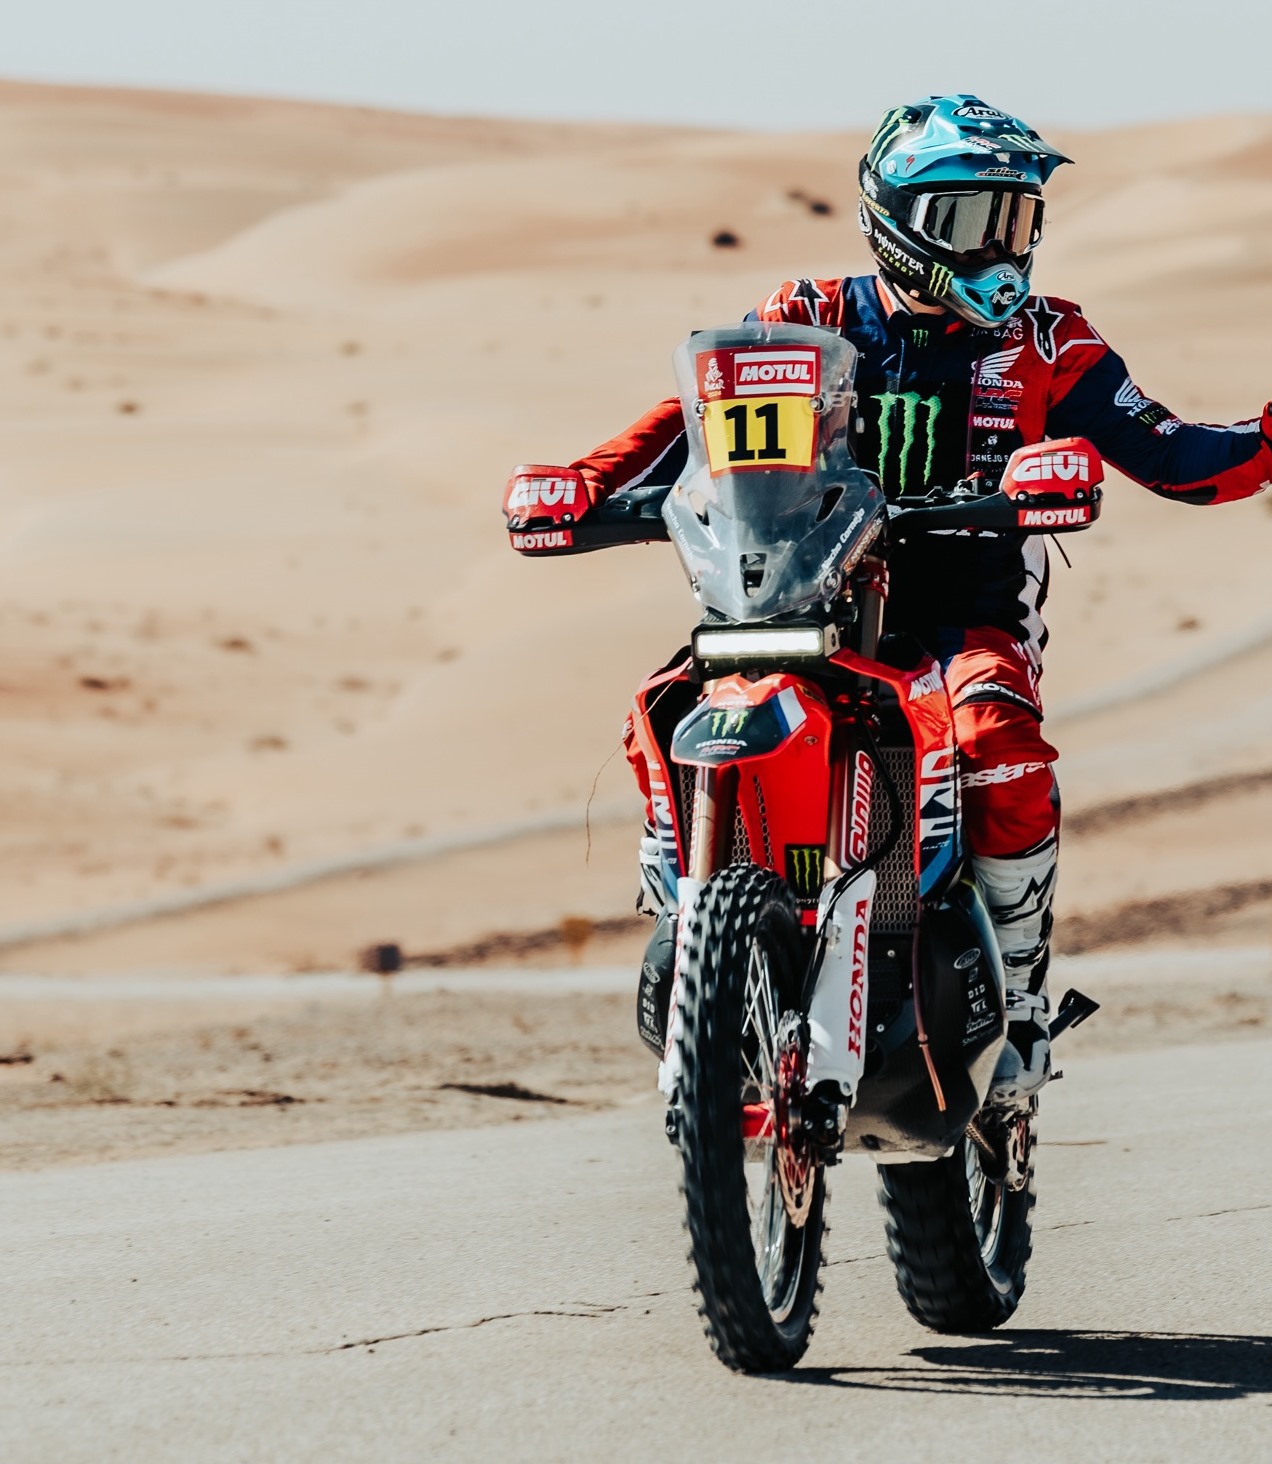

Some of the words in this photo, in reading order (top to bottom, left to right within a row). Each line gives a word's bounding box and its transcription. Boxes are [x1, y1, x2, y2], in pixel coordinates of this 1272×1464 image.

[874, 229, 924, 275] MONSTER
[878, 247, 914, 276] ENERGY
[739, 364, 811, 382] MOTUL
[971, 377, 1024, 389] HONDA
[724, 403, 787, 462] 11
[973, 416, 1016, 430] MOTUL
[1012, 453, 1089, 482] GIVI
[507, 478, 577, 509] GIVI
[840, 507, 865, 543] Cornejo
[1024, 509, 1086, 526] MOTUL
[513, 531, 567, 549] MOTUL
[695, 738, 748, 750] HONDA
[850, 750, 875, 863] SHOWA
[920, 744, 962, 843] CRF
[848, 898, 870, 1060] HONDA
